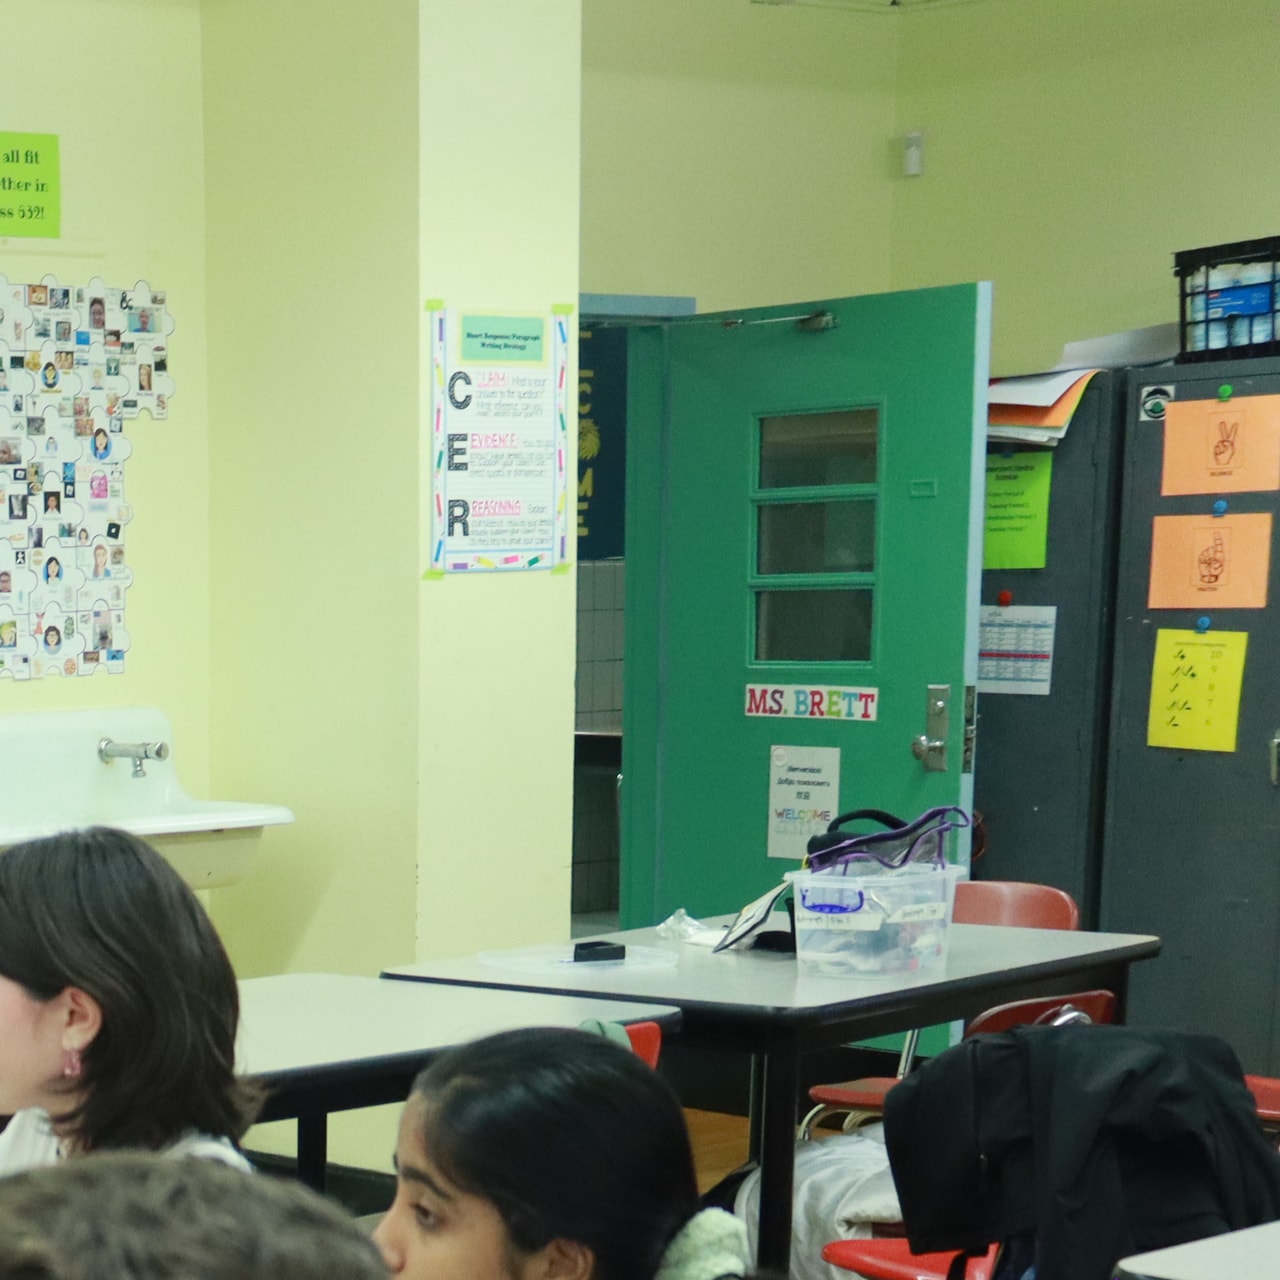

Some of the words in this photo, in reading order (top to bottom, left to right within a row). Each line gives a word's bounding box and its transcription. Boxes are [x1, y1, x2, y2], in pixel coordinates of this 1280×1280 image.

[2, 150, 20, 163] all
[24, 149, 40, 164] fit
[35, 178, 49, 193] in
[448, 371, 472, 410] C
[448, 433, 468, 471] E
[447, 499, 470, 536] R
[746, 688, 789, 716] MS.
[793, 689, 876, 720] BRETT
[775, 807, 831, 822] WELCOME
